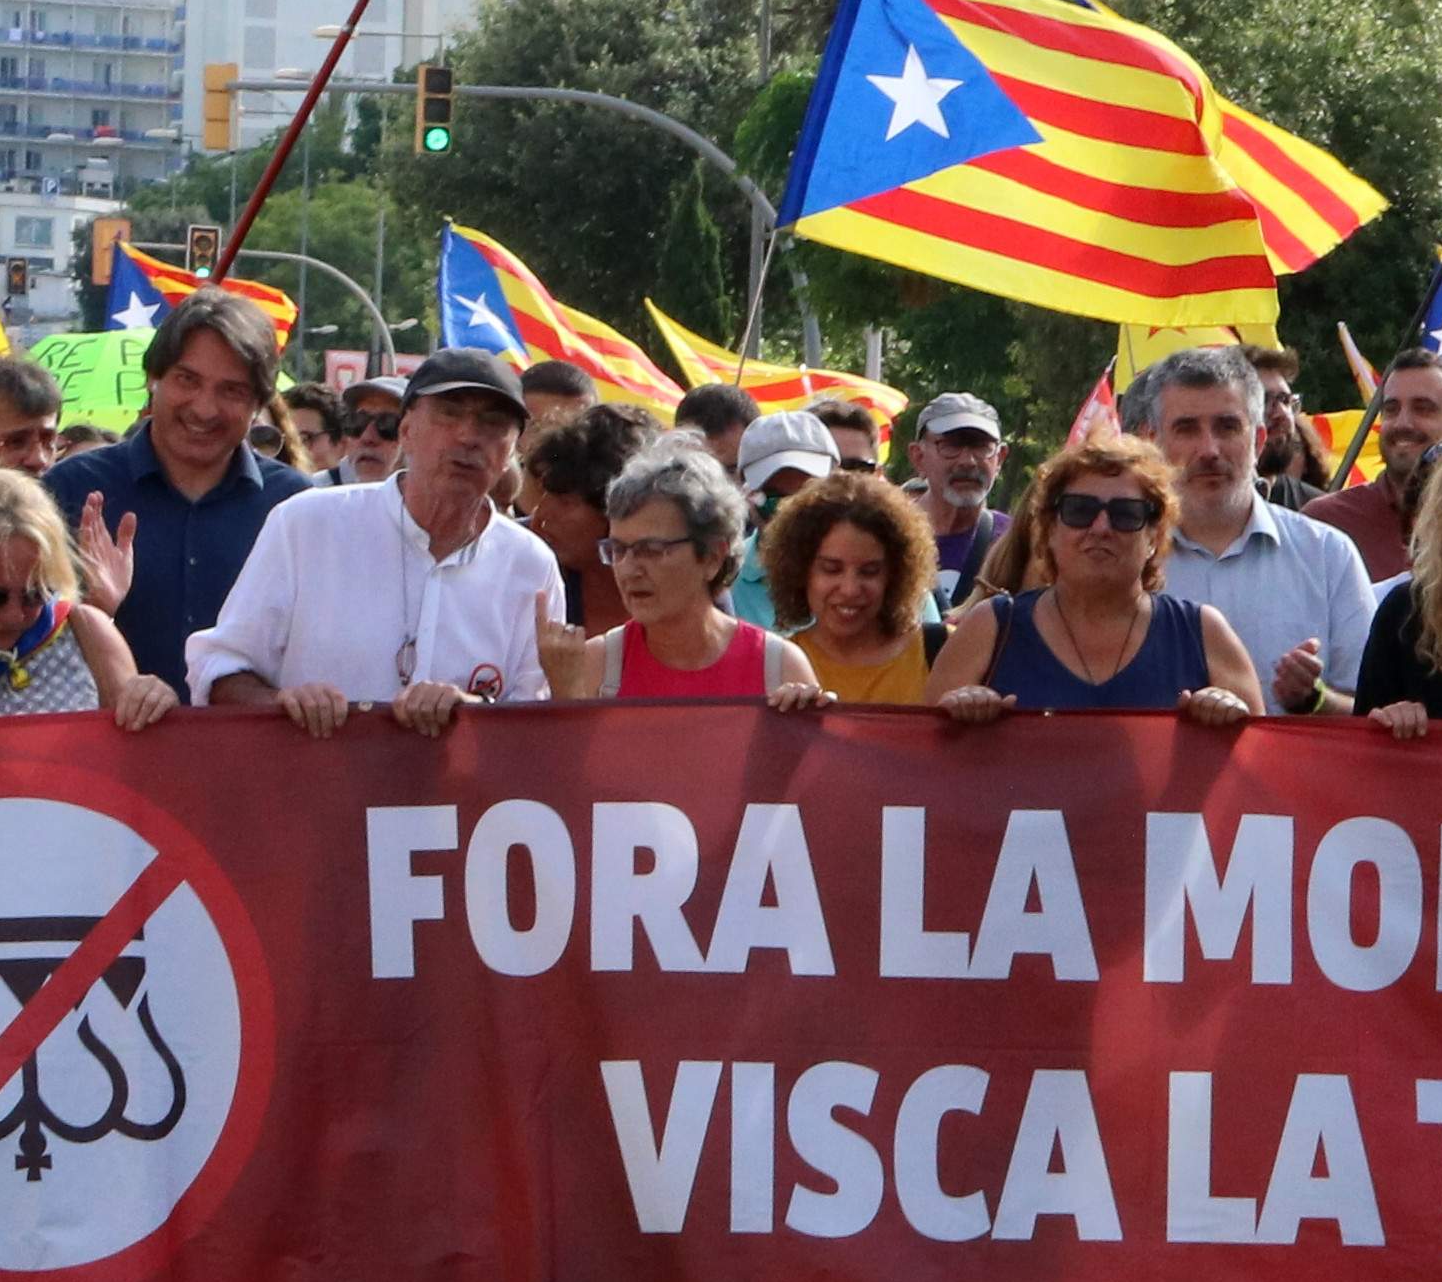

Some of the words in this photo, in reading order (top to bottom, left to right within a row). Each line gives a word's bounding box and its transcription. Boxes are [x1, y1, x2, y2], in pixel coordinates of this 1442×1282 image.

[367, 799, 835, 978] FORA
[880, 806, 1099, 981] LA
[601, 1061, 1122, 1241] VISCA
[1167, 1072, 1384, 1246] LA
